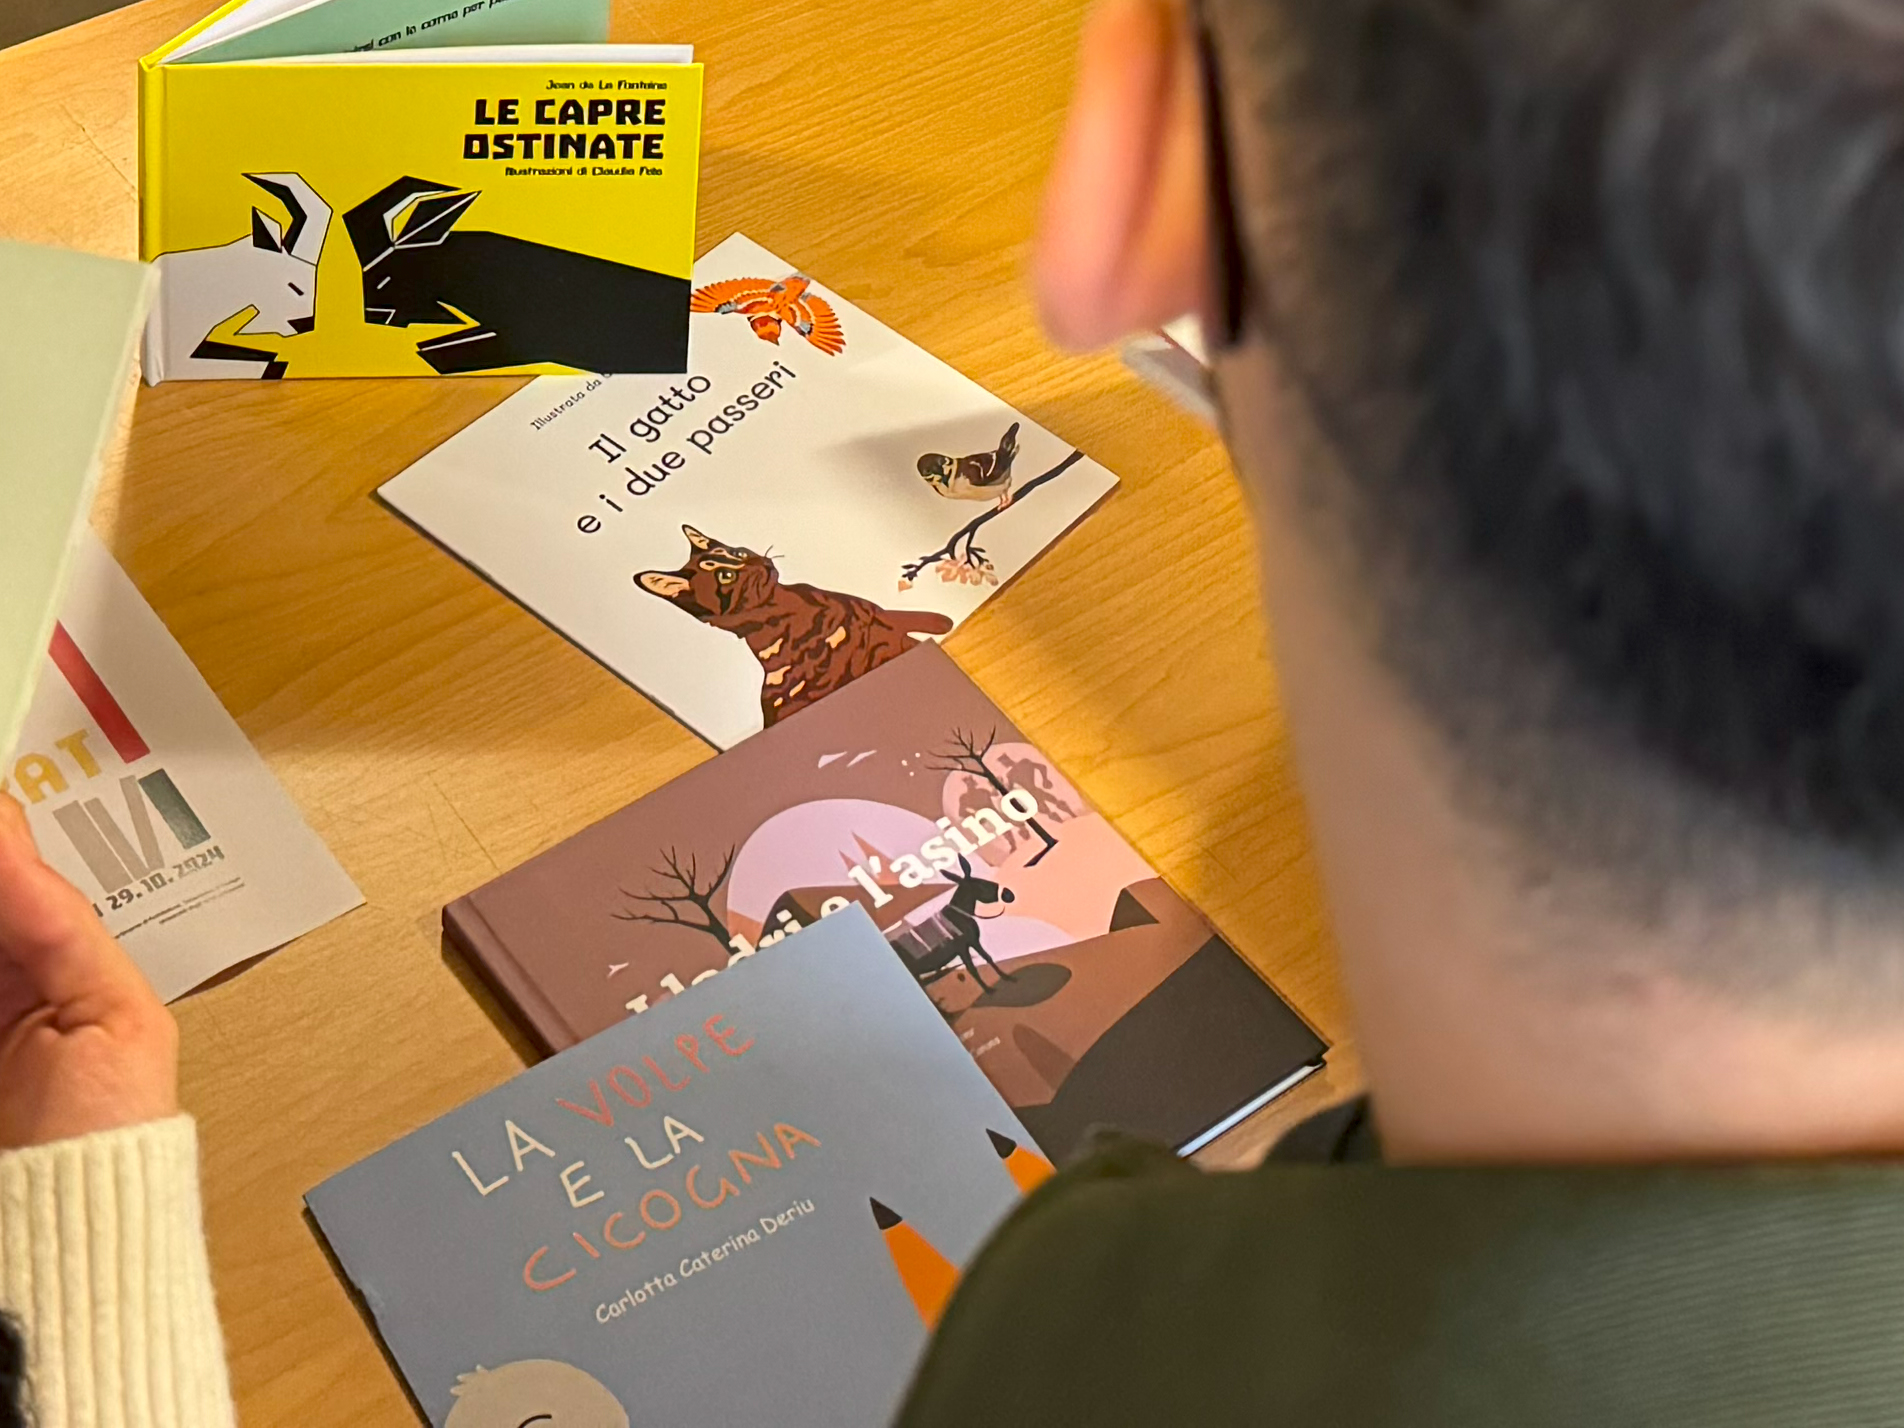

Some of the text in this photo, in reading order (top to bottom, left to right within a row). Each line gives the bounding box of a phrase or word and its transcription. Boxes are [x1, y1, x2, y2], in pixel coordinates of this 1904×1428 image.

[463, 133, 664, 160] OSTINATE
[475, 99, 666, 125] LE CAPRE
[530, 379, 602, 431] Illustrata da
[577, 361, 796, 534] e i due passeri
[588, 375, 711, 464] Il gatto
[105, 845, 225, 911] 29.10.2024
[847, 787, 1039, 909] l'asino
[451, 1013, 755, 1196] LA VOLPE
[523, 1122, 821, 1291] CICOGNA
[560, 1116, 704, 1208] E LA
[595, 1197, 816, 1323] Carlotta Caterina Deriu
